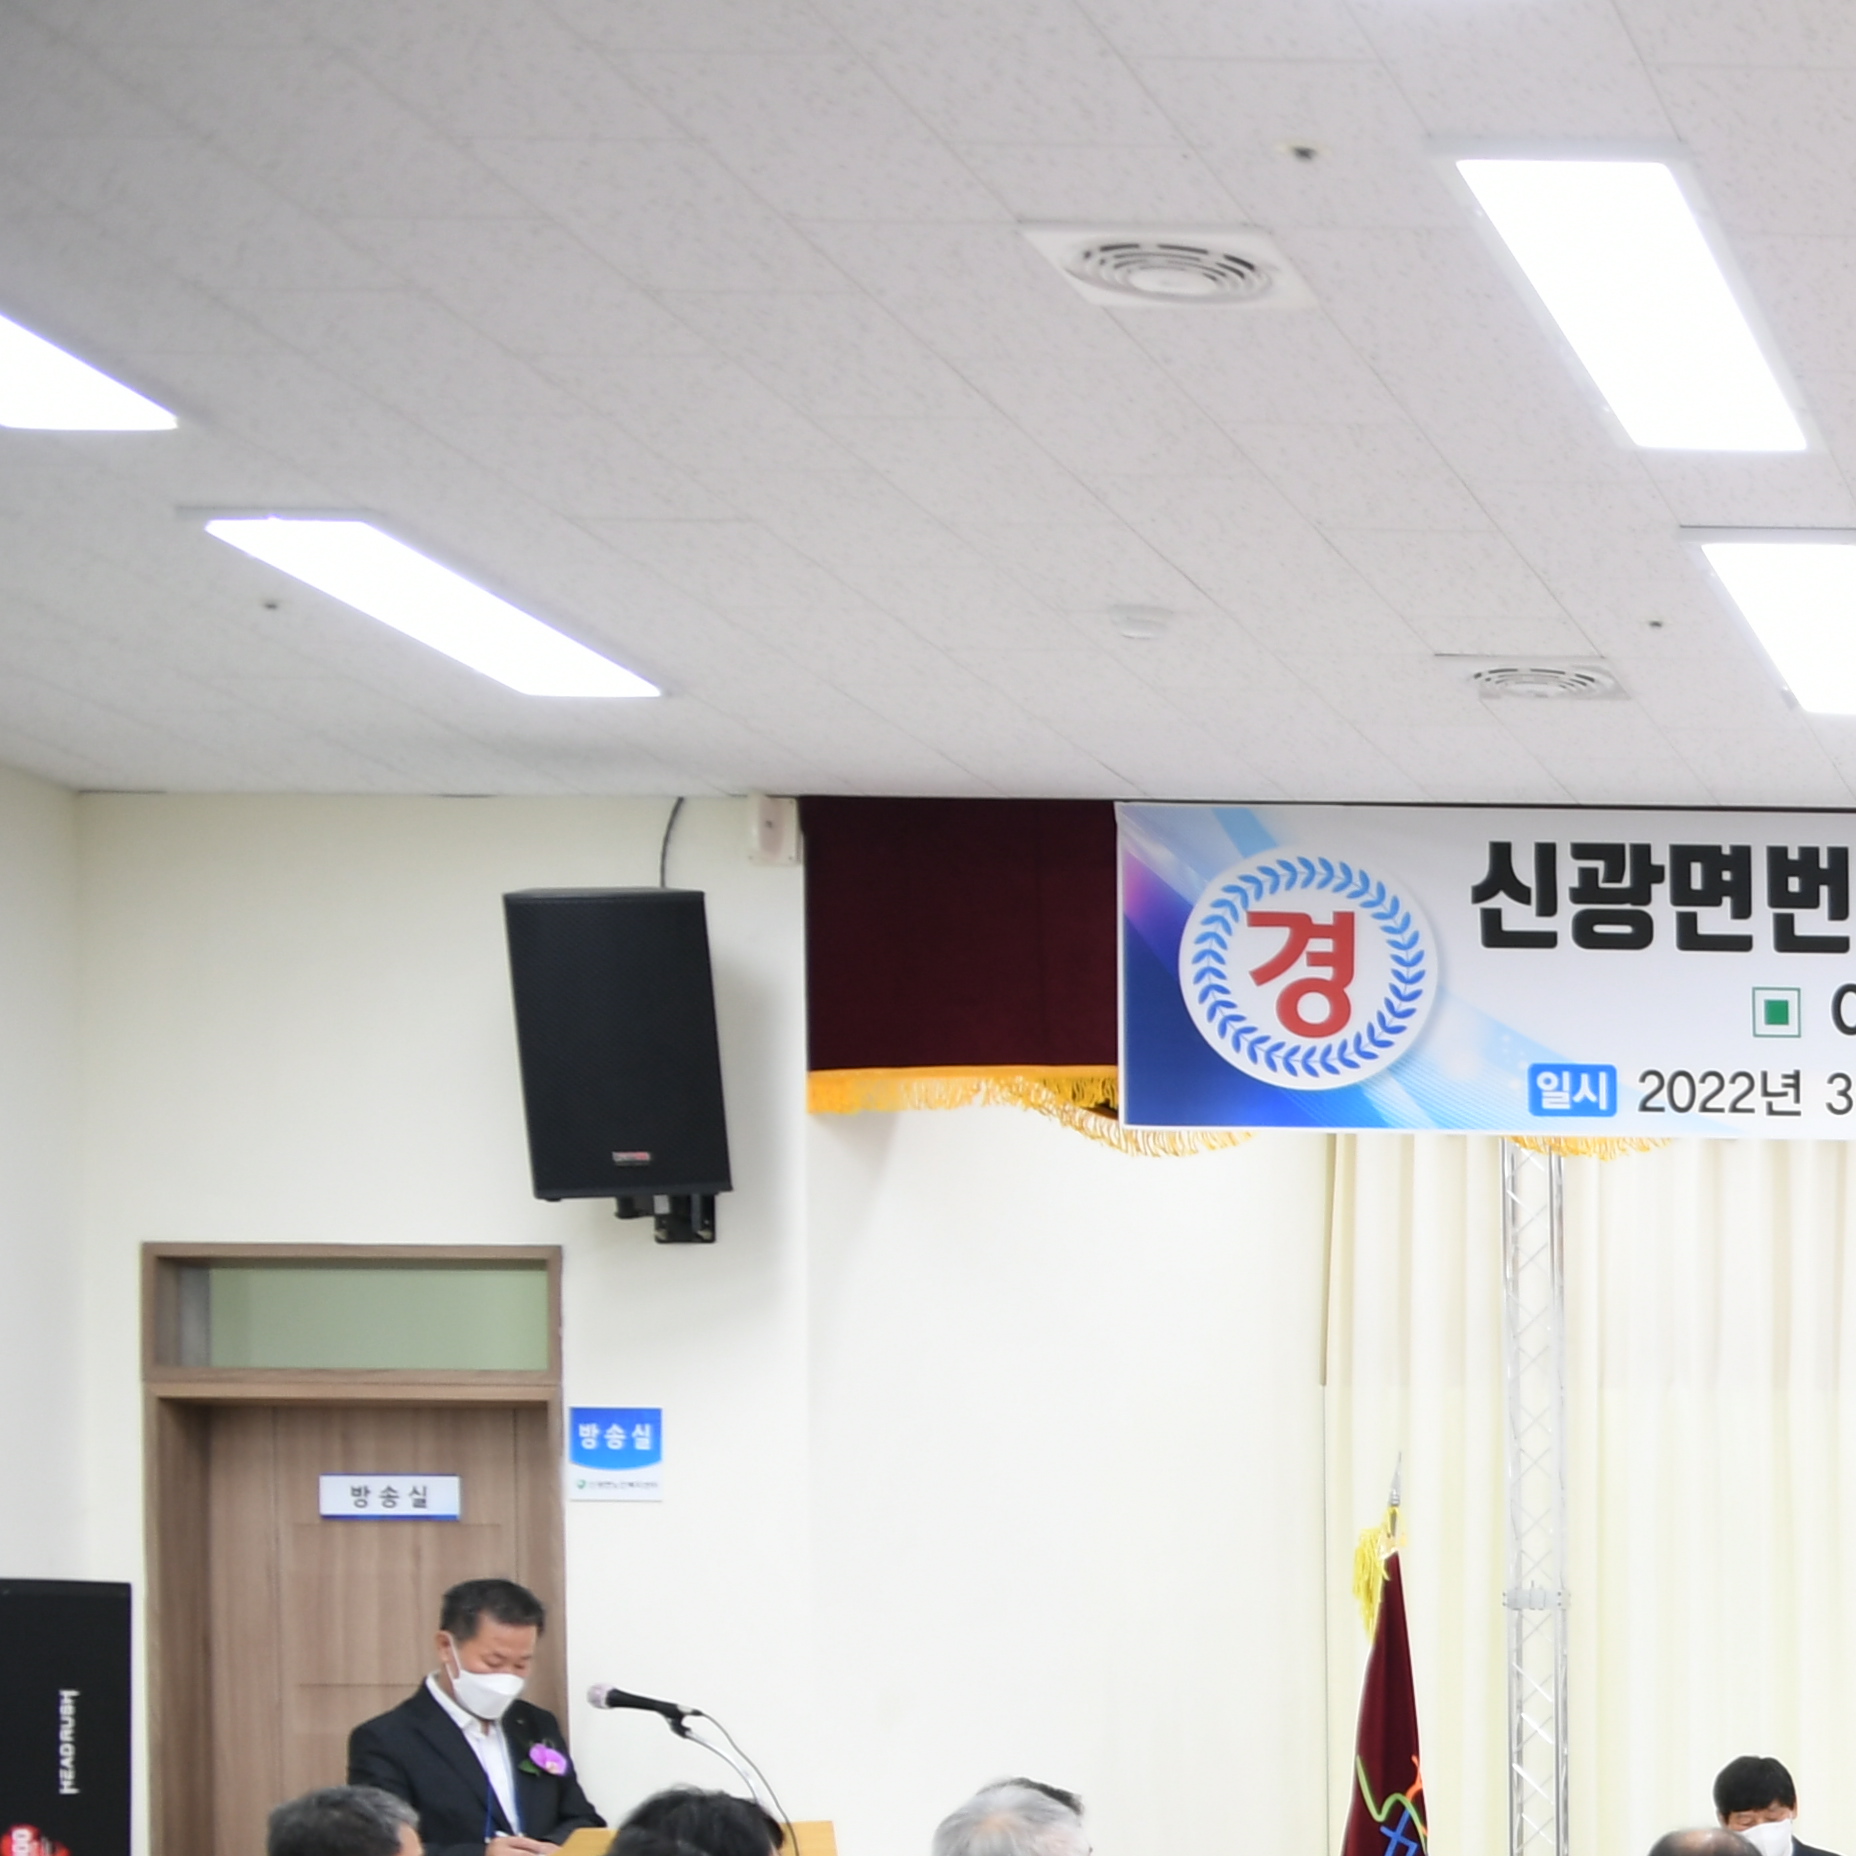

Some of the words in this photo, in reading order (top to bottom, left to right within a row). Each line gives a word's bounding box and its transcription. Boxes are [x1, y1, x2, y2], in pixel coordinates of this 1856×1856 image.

[1248, 911, 1356, 1039] 경
[1536, 1070, 1607, 1111] 일시
[1639, 1069, 1802, 1117] 2022년
[59, 1689, 80, 1795] HEADRUSH
